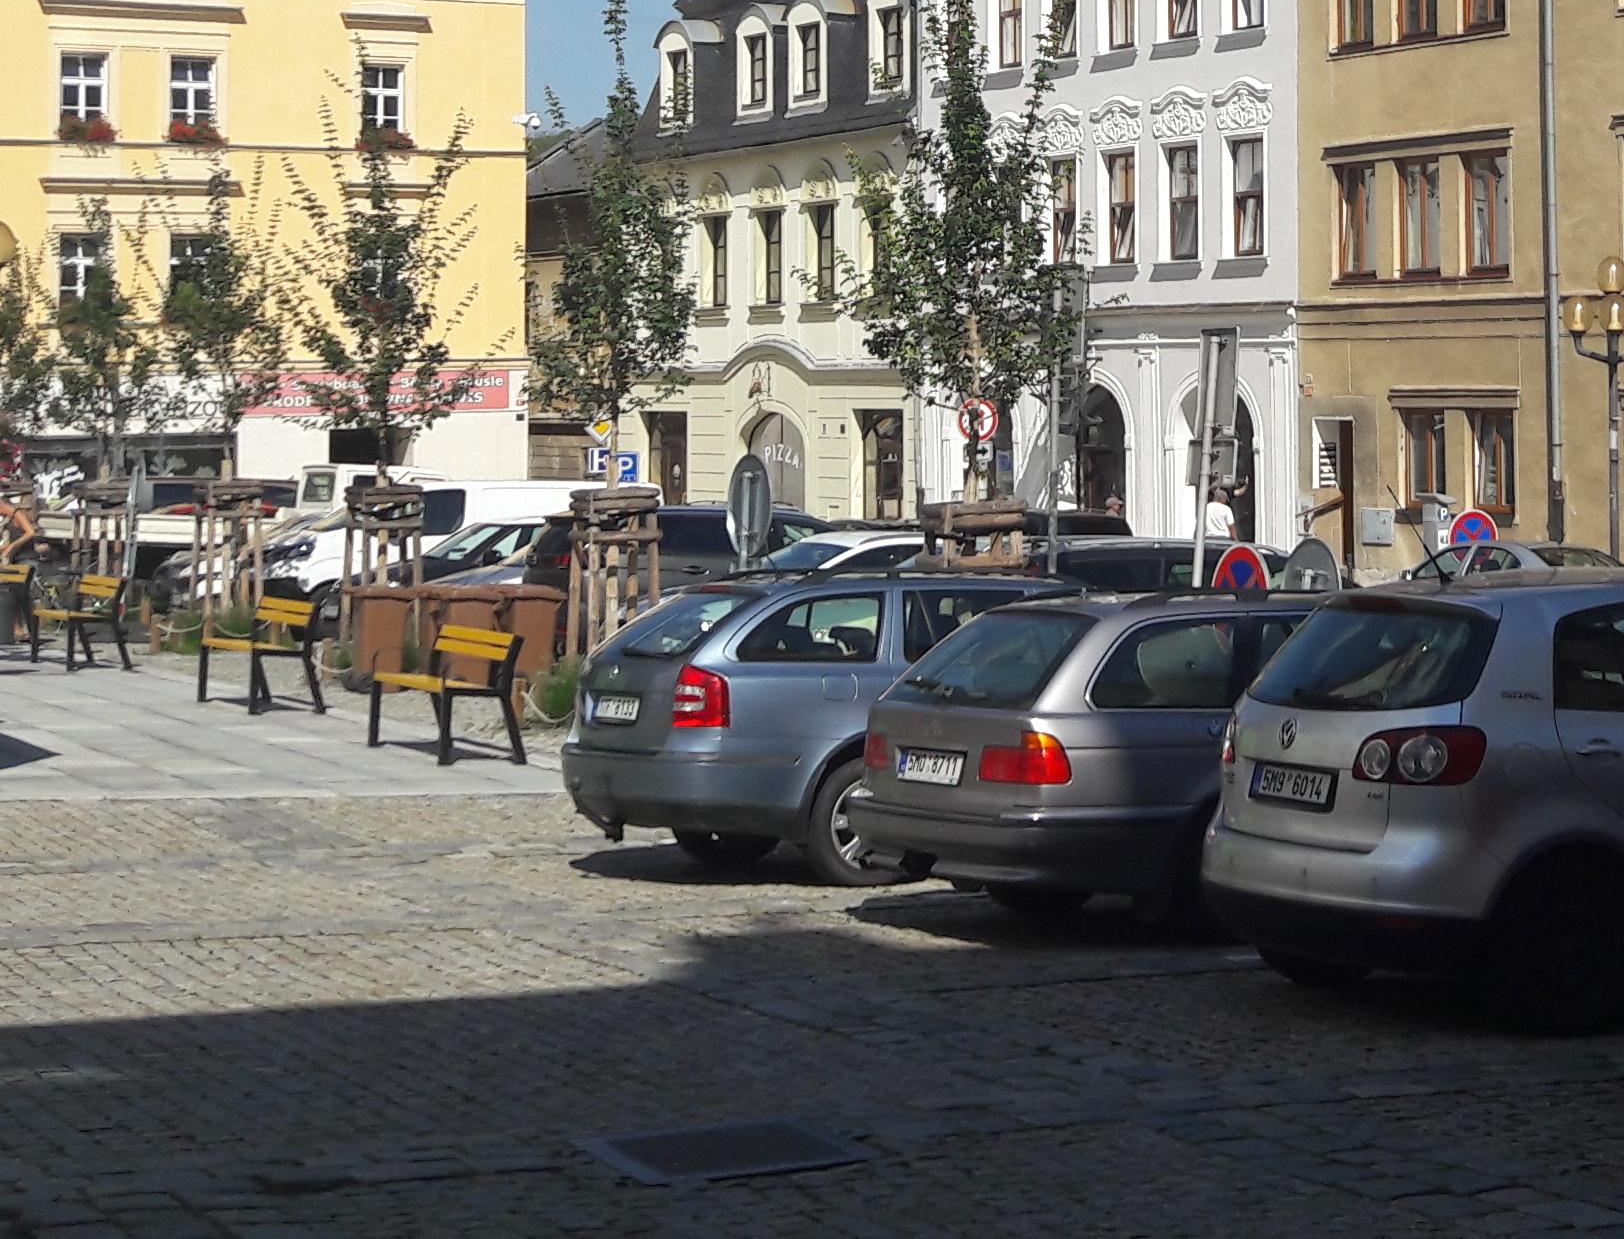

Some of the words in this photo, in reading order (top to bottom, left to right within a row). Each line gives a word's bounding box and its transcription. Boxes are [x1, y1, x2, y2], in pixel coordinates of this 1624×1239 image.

[764, 443, 800, 470] PIZZA
[1440, 508, 1448, 521] P
[1261, 768, 1286, 793] 5M9
[1291, 774, 1323, 801] 6014
